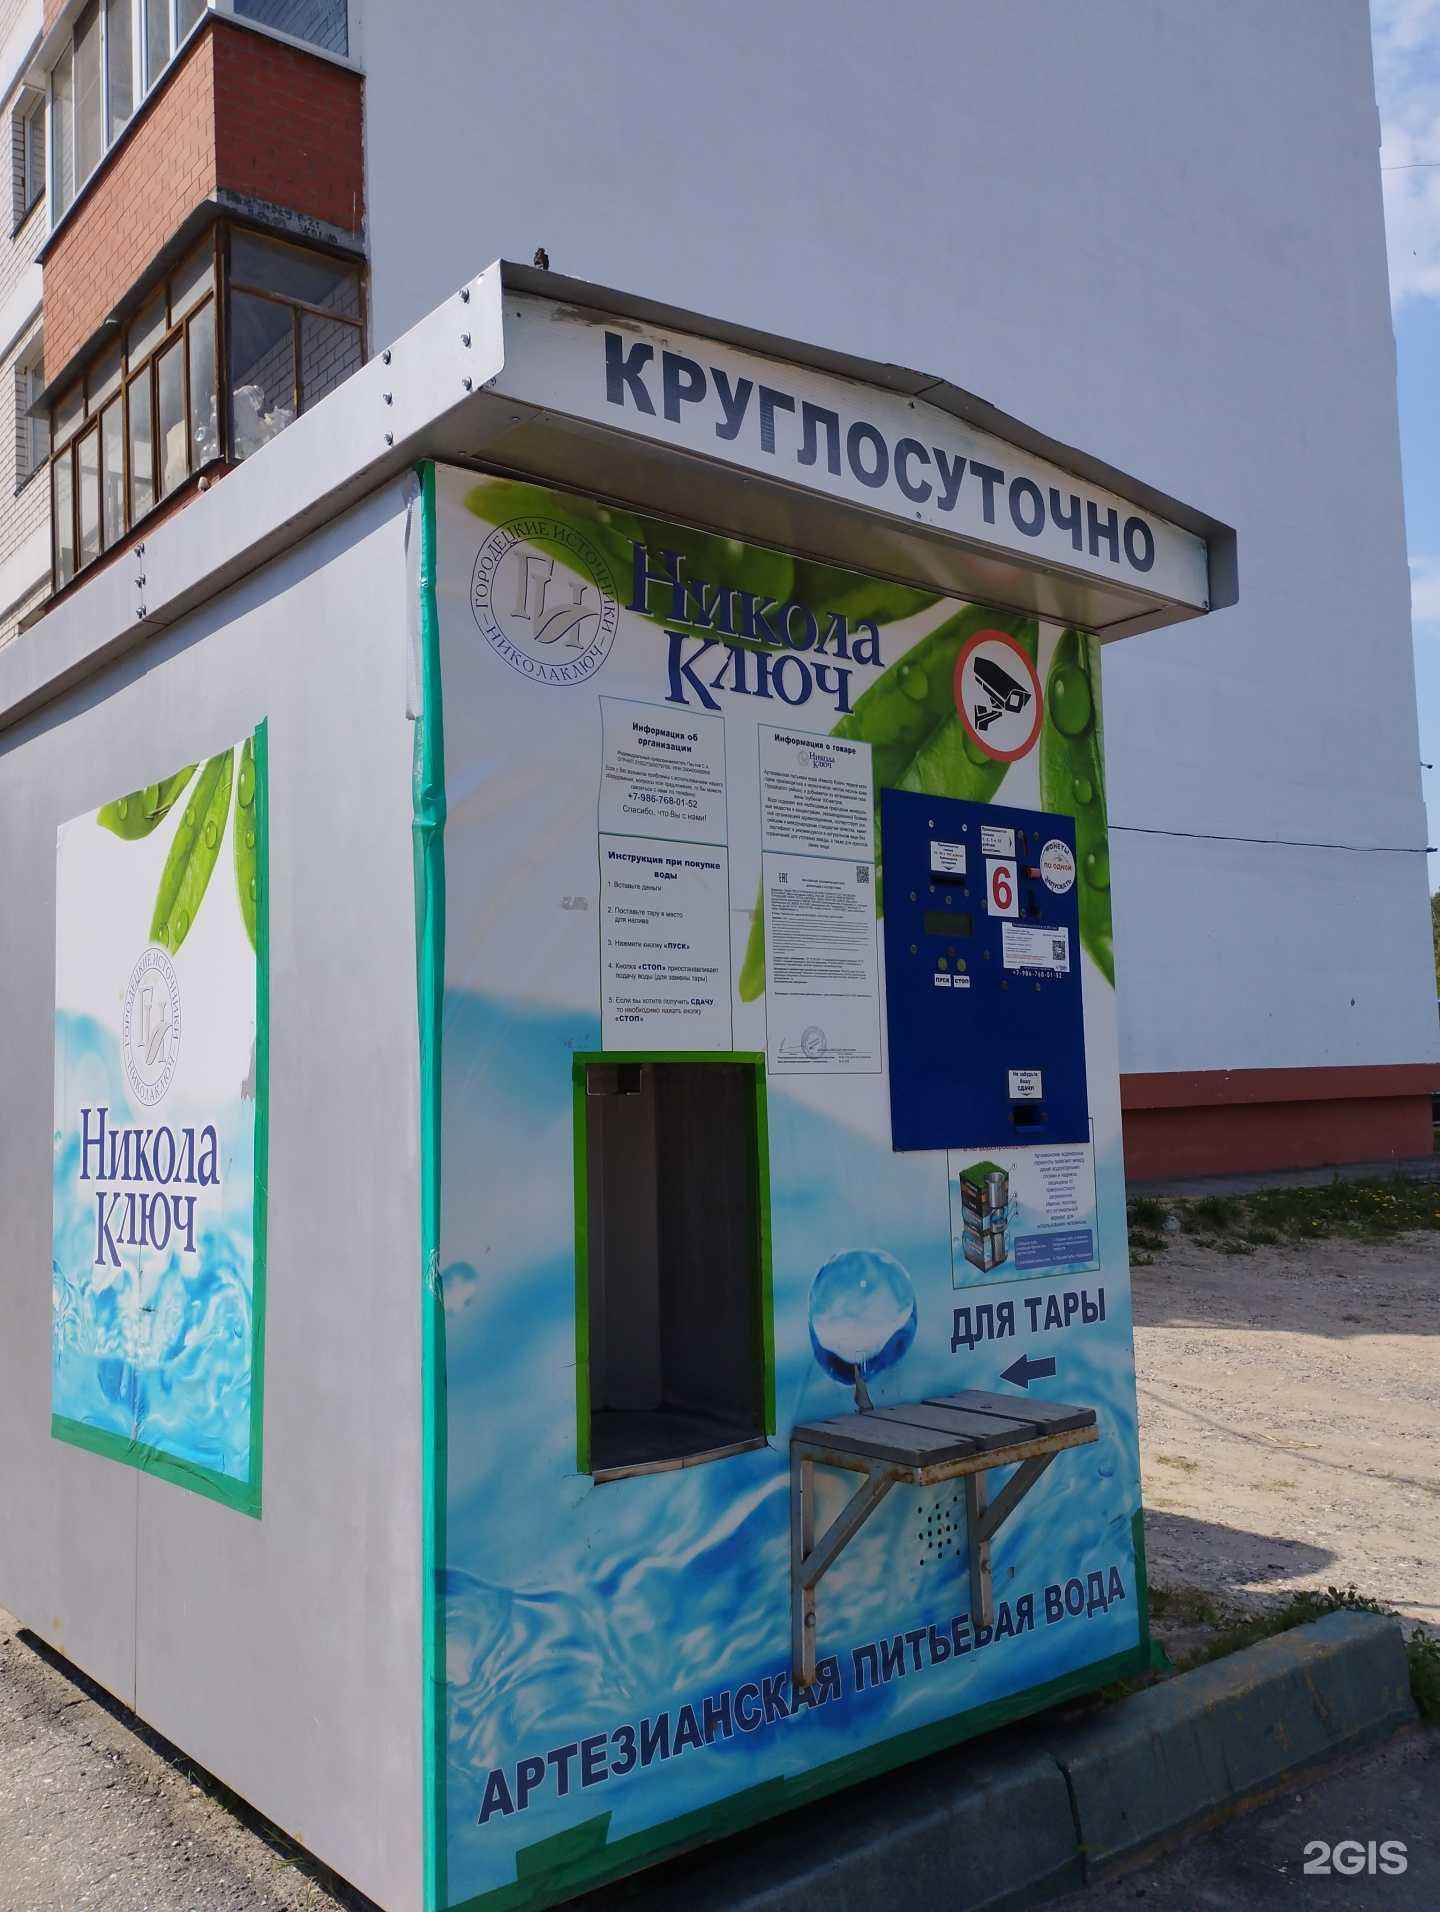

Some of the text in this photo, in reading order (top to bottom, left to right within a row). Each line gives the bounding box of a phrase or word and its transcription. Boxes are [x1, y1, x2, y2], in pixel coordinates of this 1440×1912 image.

[605, 331, 1157, 572] КРУГЛОСУТОЧНО
[475, 521, 617, 633] ГОРОДЕЦКИЕ ИСТОЧНИКИ
[626, 540, 885, 667] Никола
[486, 625, 604, 683] НИКОЛАКЛЮЧ
[664, 630, 855, 713] Ключ
[632, 722, 698, 742] Информация об
[638, 738, 692, 753] организации
[774, 733, 824, 750] Информация
[832, 745, 857, 755] товаре
[657, 809, 669, 817] что
[670, 810, 680, 818] Вы
[608, 851, 721, 870] Инструкция при покупке
[654, 871, 678, 880] воды
[992, 866, 1013, 910] 6
[638, 963, 666, 971] «СТОП»
[80, 1107, 220, 1187] Никола
[95, 1191, 197, 1267] Ключ
[951, 1288, 1105, 1354] ДЛЯ ТАРЫ
[478, 1657, 842, 1825] АРТЕЗИАНСКАЯ
[1044, 1566, 1127, 1625] ВОДА
